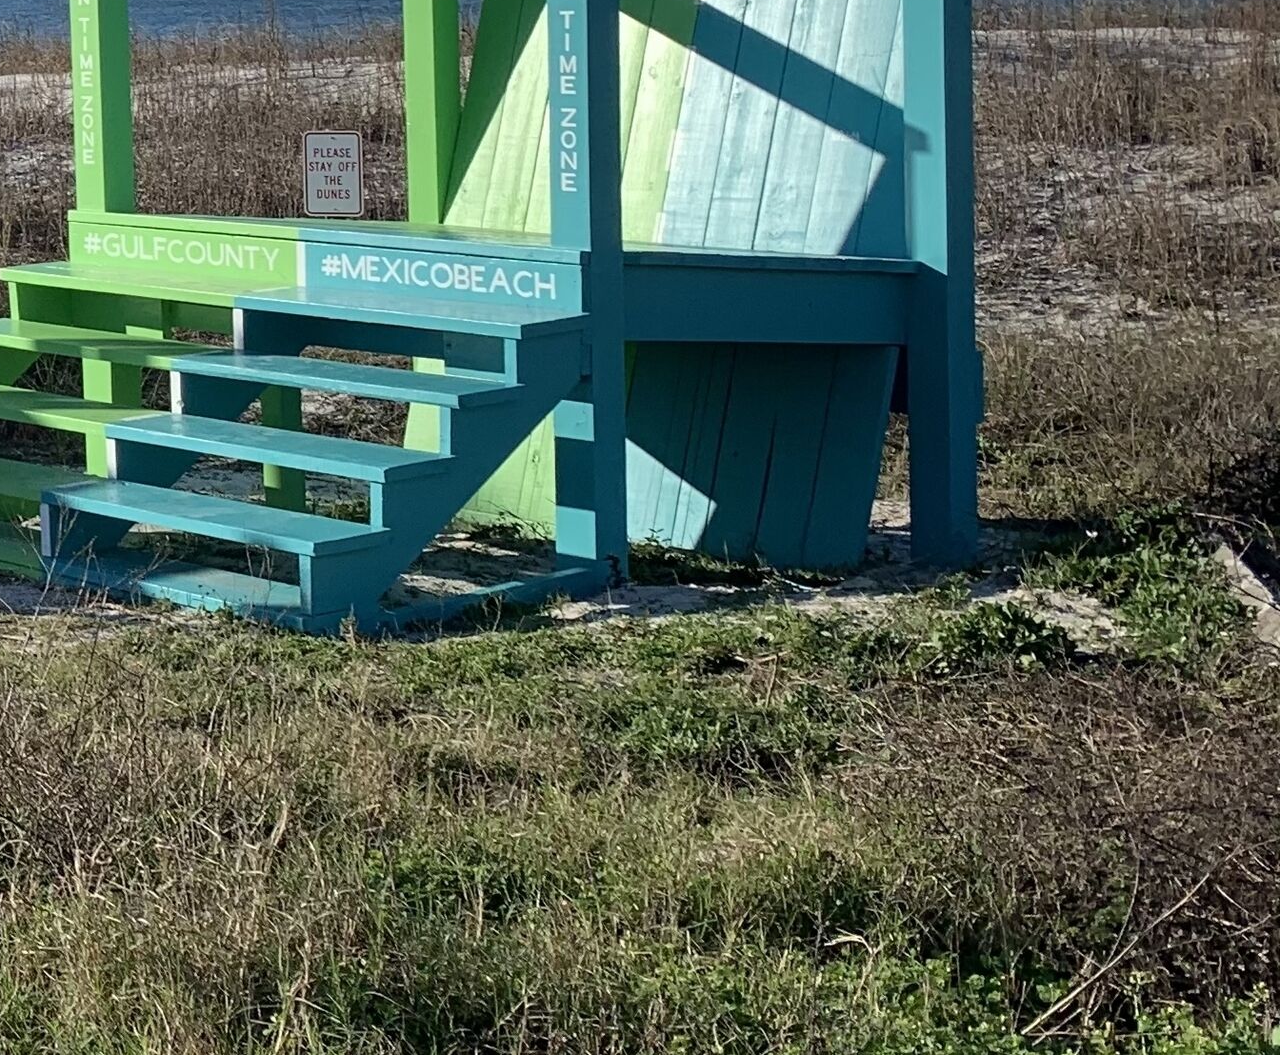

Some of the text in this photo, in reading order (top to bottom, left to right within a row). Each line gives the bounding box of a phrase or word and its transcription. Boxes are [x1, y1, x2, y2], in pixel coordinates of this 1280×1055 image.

[79, 17, 93, 87] TIME
[559, 10, 577, 95] TIME
[81, 95, 95, 165] ZONE
[560, 108, 578, 193] ZONE
[308, 161, 358, 172] STAY OFF
[313, 148, 351, 158] PLEASE
[316, 189, 351, 199] DUNES
[323, 175, 343, 186] THE
[83, 231, 280, 272] #GULFCOUNTY
[321, 252, 556, 300] #MEXICOBEACH
